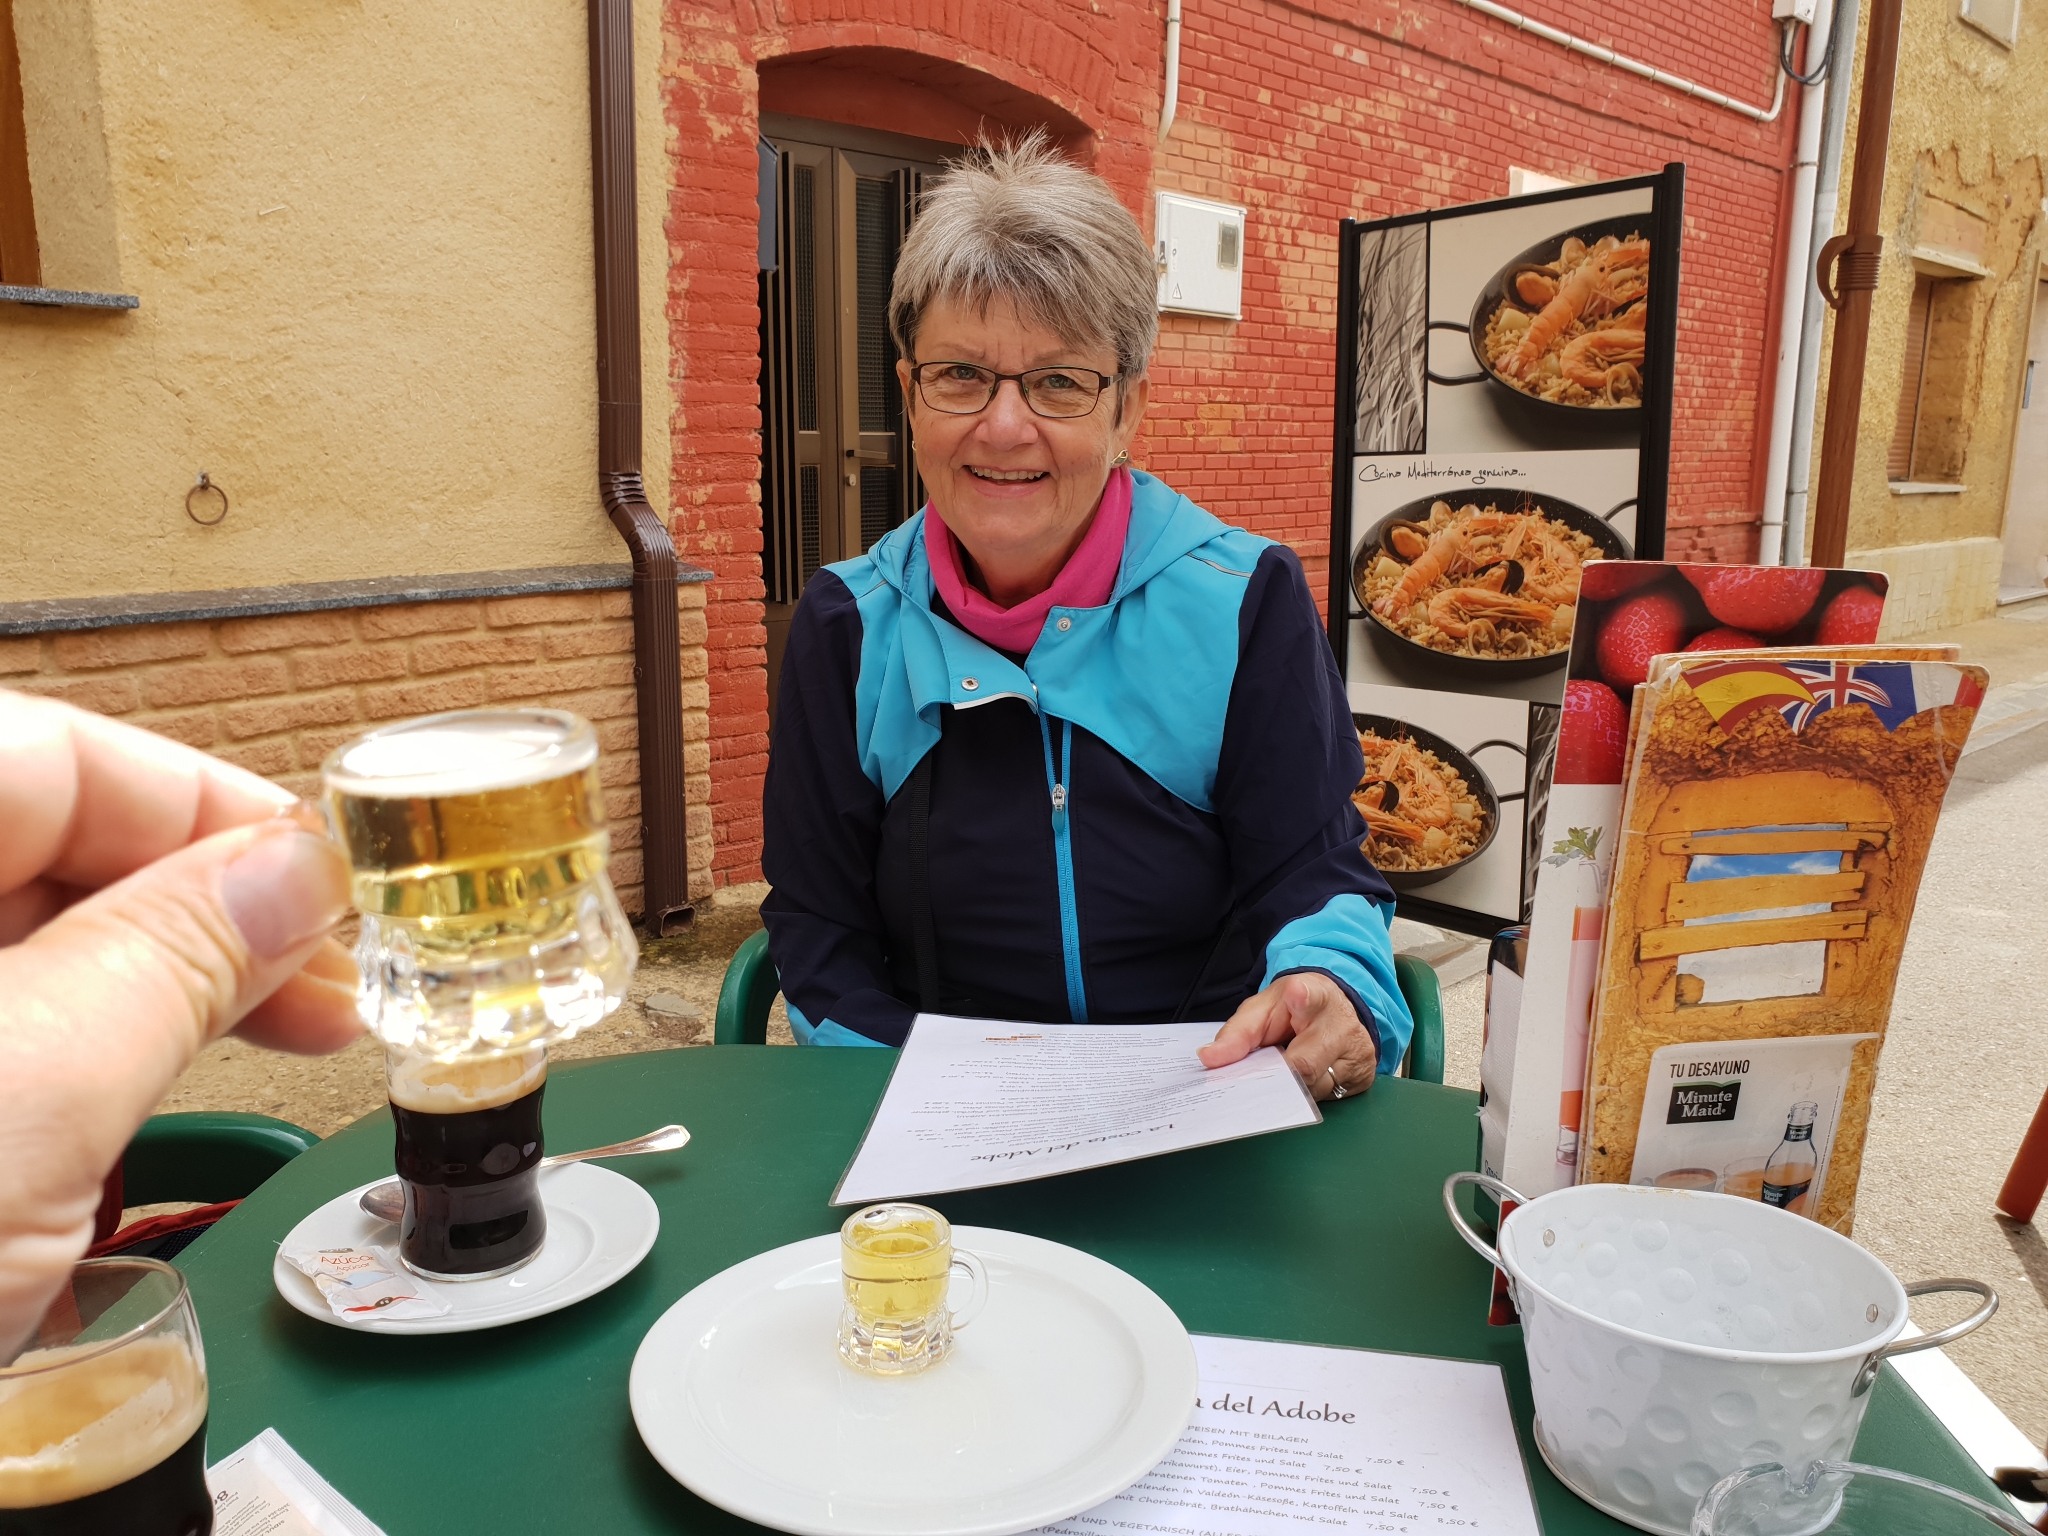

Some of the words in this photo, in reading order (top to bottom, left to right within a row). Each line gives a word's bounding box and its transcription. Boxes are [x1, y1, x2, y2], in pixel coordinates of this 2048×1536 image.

[1670, 1063, 1685, 1079] TU
[1687, 1059, 1750, 1078] DESAYUNO
[1676, 1090, 1733, 1105] Minute
[1681, 1102, 1723, 1118] Maid
[970, 1147, 1042, 1162] Adobe
[1047, 1141, 1080, 1153] del
[1211, 1393, 1255, 1414] del
[1261, 1400, 1356, 1424] Adobe
[1185, 1425, 1226, 1435] PEISEN
[1229, 1429, 1250, 1438] MIT
[1253, 1433, 1309, 1443] BEILAGEN
[1174, 1447, 1218, 1459] Pommes
[1221, 1453, 1251, 1463] Frites
[1254, 1457, 1275, 1465] und
[1279, 1459, 1307, 1468] Salat
[1211, 1439, 1256, 1450] Pommes
[1259, 1445, 1289, 1455] Frites
[1292, 1449, 1313, 1457] und
[1317, 1451, 1344, 1461] Salat
[1254, 1469, 1300, 1481] Pommes
[1304, 1475, 1335, 1485] Frites
[1338, 1480, 1359, 1488] und
[1363, 1481, 1393, 1491] Salat
[1201, 1476, 1248, 1488] Tomaten
[1260, 1482, 1306, 1494] Pommes
[1310, 1488, 1341, 1499] Frites
[1345, 1493, 1366, 1501] und
[1370, 1495, 1400, 1505] Salat
[1114, 1493, 1135, 1502] mit
[1293, 1513, 1315, 1522] und
[1319, 1516, 1348, 1527] Salat
[1183, 1487, 1193, 1495] in
[1302, 1501, 1359, 1515] Kartoffeln
[1363, 1509, 1385, 1518] und
[1389, 1511, 1419, 1521] Salat
[1081, 1516, 1108, 1525] UND
[1112, 1520, 1195, 1535] VEGETARISCH
